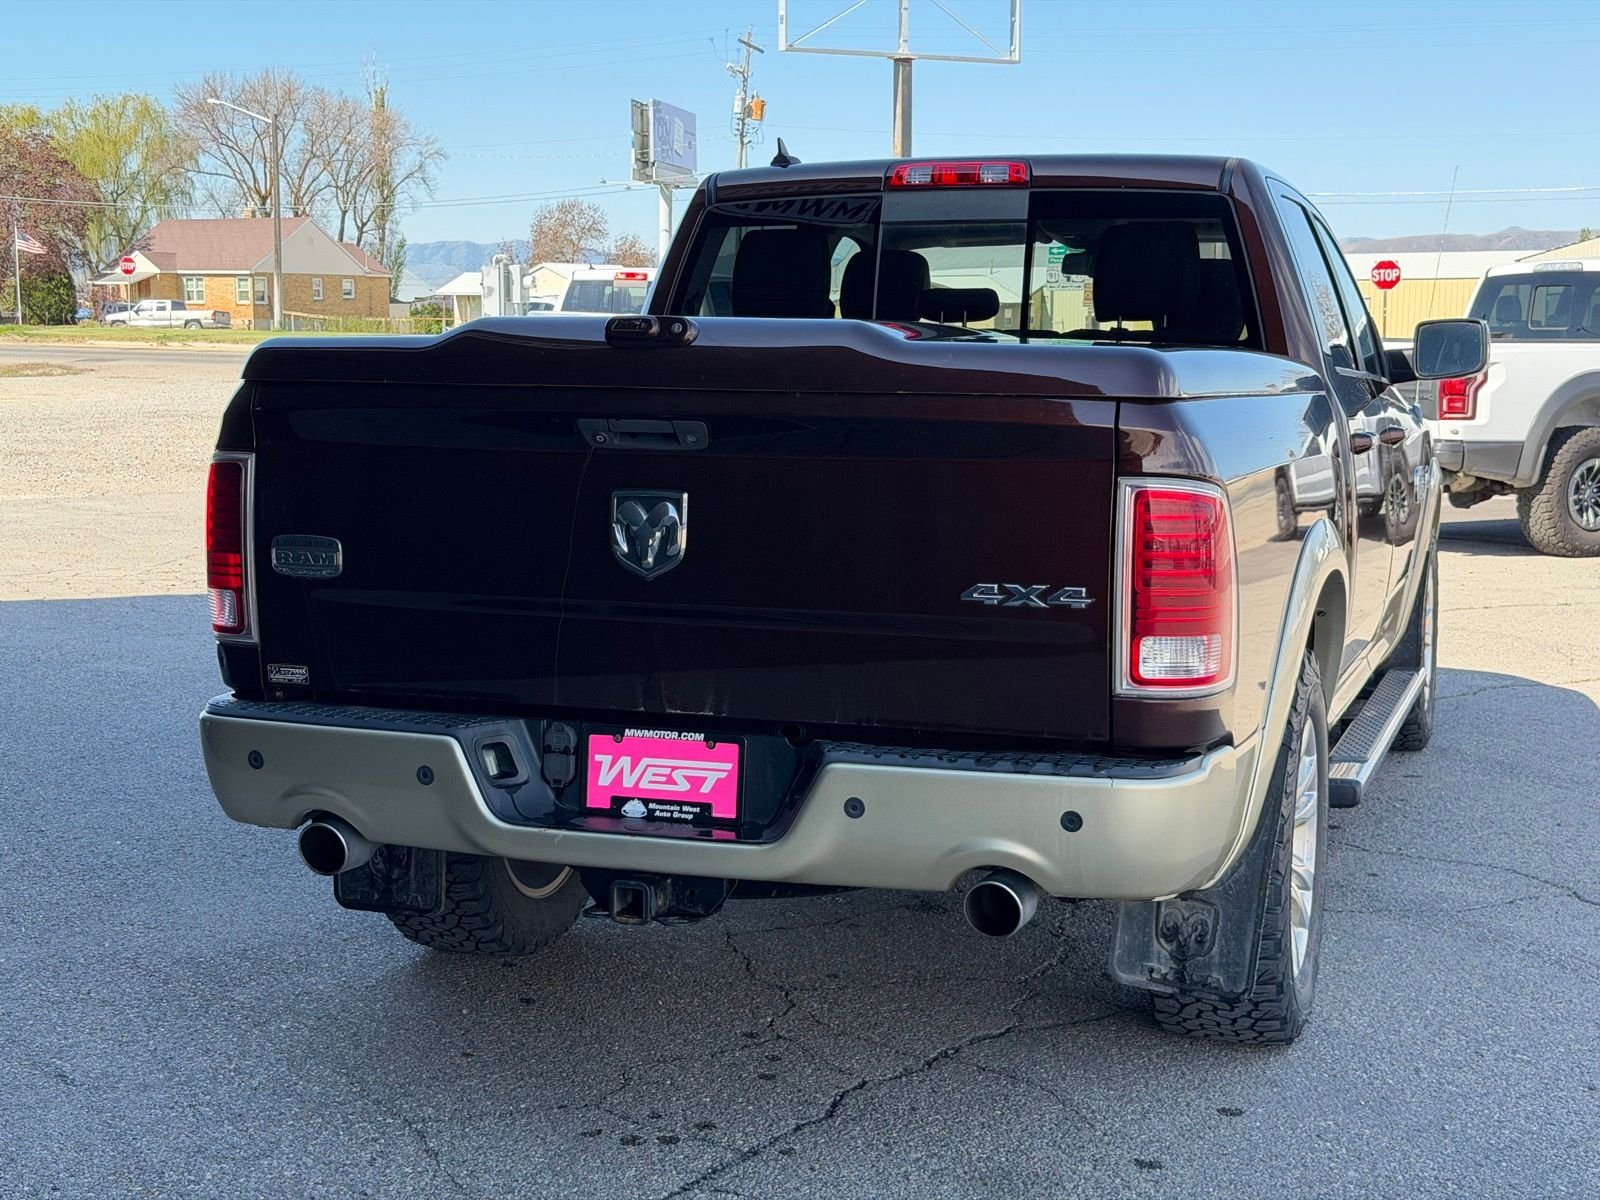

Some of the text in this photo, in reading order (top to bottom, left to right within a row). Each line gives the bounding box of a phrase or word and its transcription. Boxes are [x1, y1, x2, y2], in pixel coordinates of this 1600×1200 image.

[121, 262, 136, 270] STOP
[1372, 268, 1400, 282] STOP
[275, 550, 337, 566] RAM
[960, 583, 1096, 609] 4X4
[624, 728, 705, 741] MWMOTOR.COM
[648, 802, 681, 812] Mountain
[682, 805, 701, 813] West
[654, 810, 671, 818] Auto
[673, 811, 694, 821] Group
